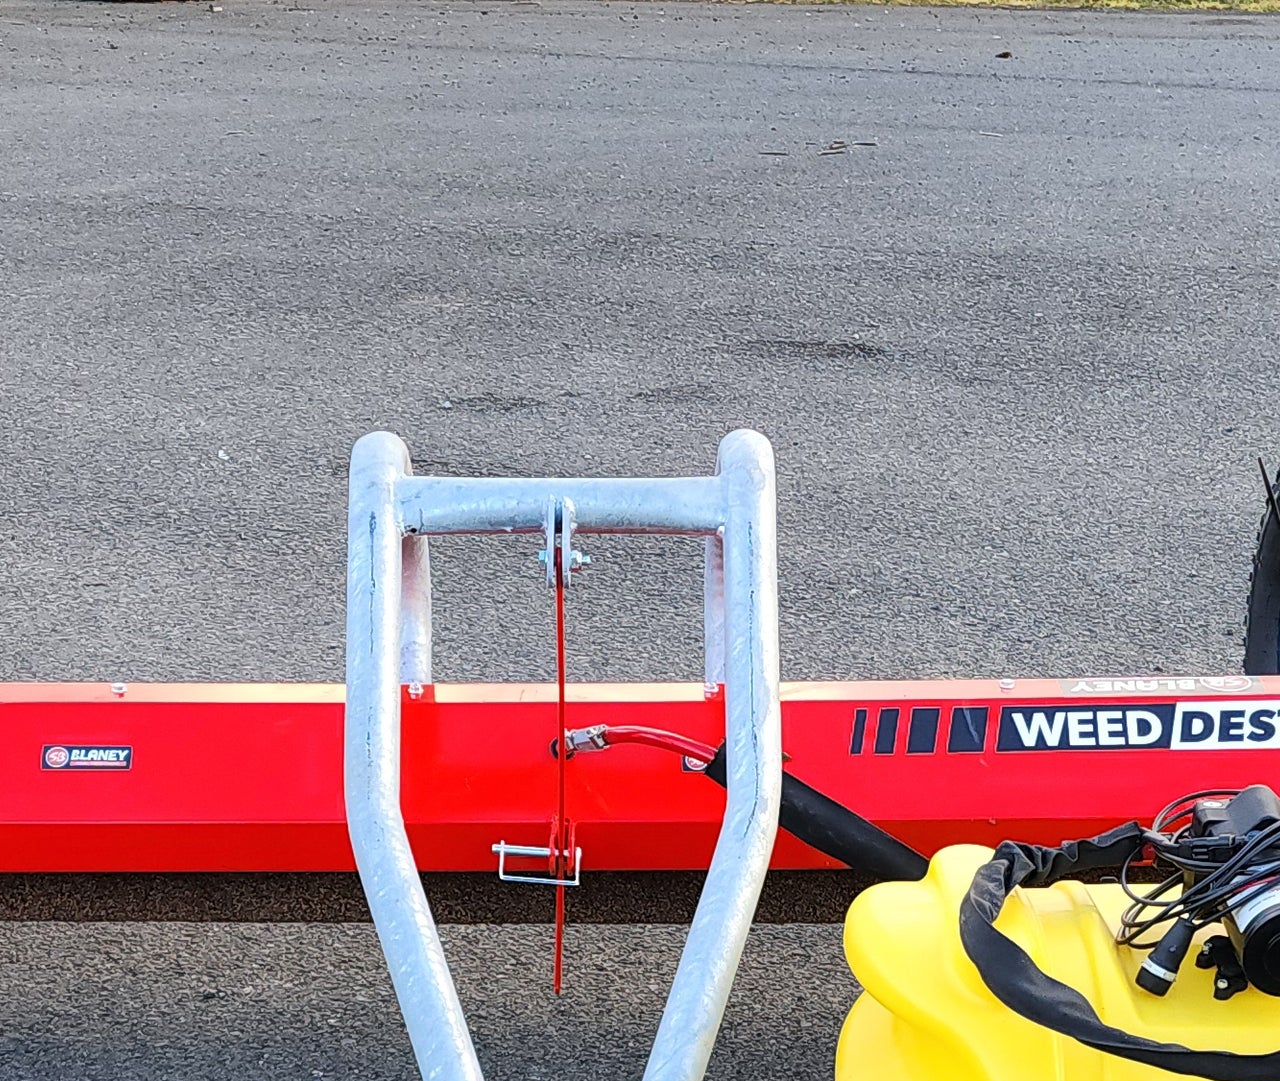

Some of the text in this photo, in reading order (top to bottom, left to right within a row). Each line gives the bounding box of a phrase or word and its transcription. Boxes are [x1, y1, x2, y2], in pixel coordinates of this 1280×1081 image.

[1070, 679, 1196, 693] BLANEY
[1011, 710, 1162, 747] WEED
[70, 749, 129, 761] BLANEY
